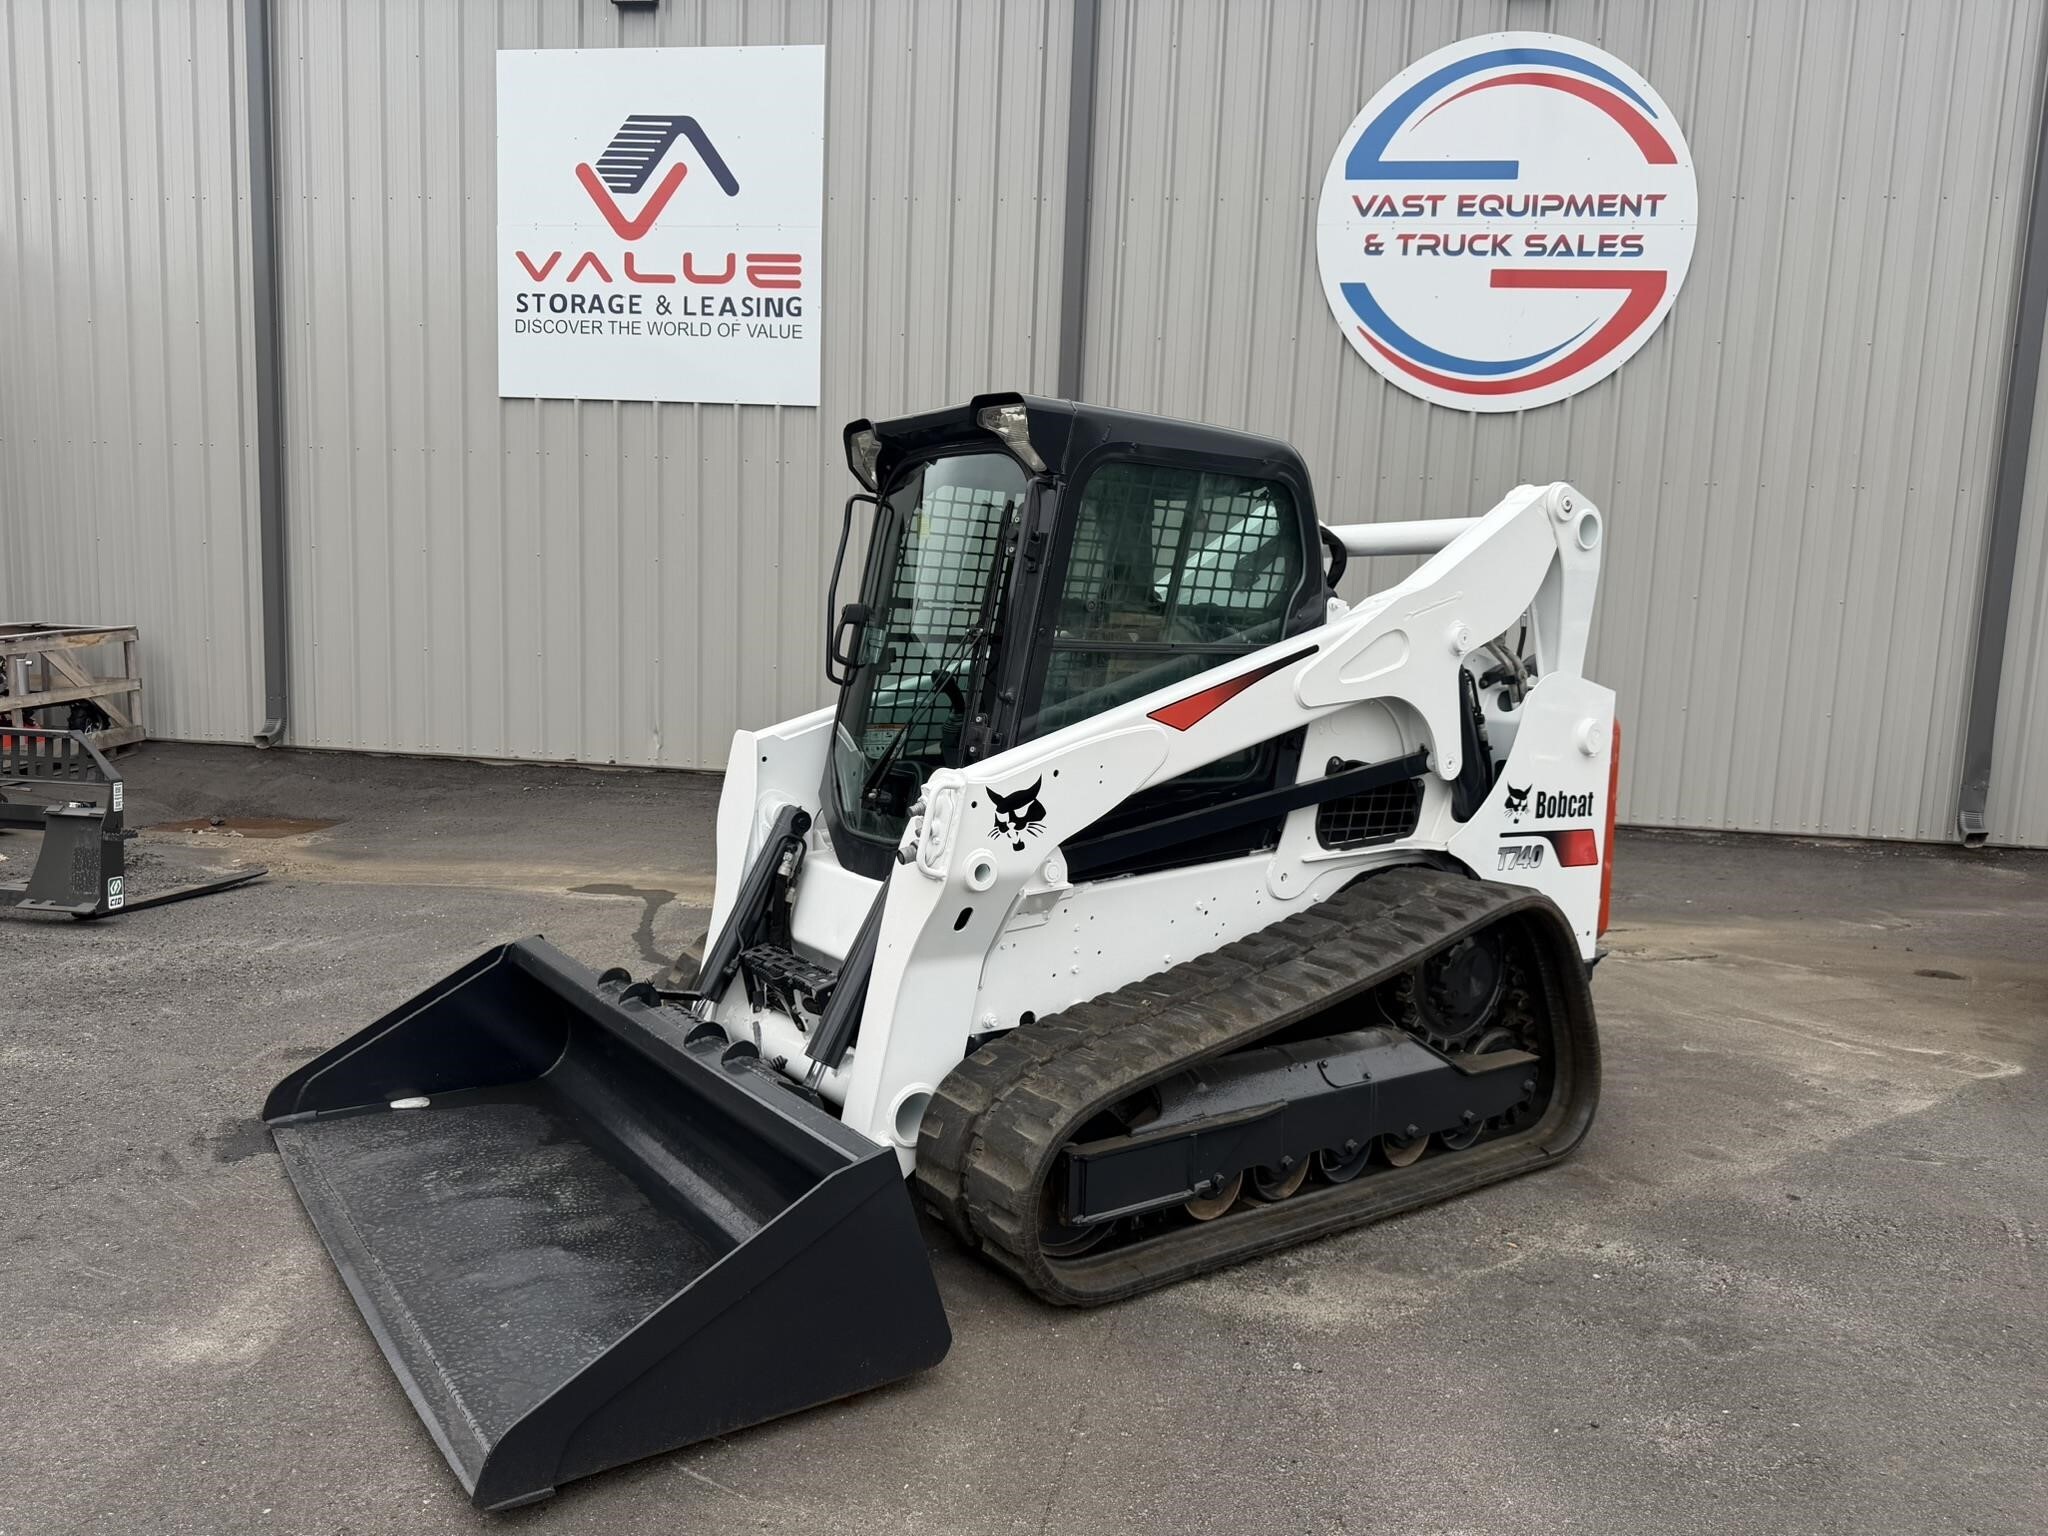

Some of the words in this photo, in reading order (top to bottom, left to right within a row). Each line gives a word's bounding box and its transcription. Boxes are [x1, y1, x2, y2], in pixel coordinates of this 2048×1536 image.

[1351, 194, 1447, 218] VAST
[1456, 193, 1668, 218] EQUIPMENT
[1363, 233, 1385, 257] &
[1395, 233, 1513, 257] TRUCK
[1523, 234, 1645, 258] SALES
[514, 250, 802, 290] VALUE
[515, 292, 642, 315] STORAGE
[655, 294, 673, 316] &
[683, 295, 802, 318] LEASING
[514, 318, 603, 335] DISCOVER
[607, 320, 642, 336] THE
[646, 321, 712, 337] WORLD
[717, 322, 742, 338] OF
[746, 323, 803, 340] VALUE
[1535, 790, 1594, 819] Bobcat
[1497, 844, 1545, 871] T740
